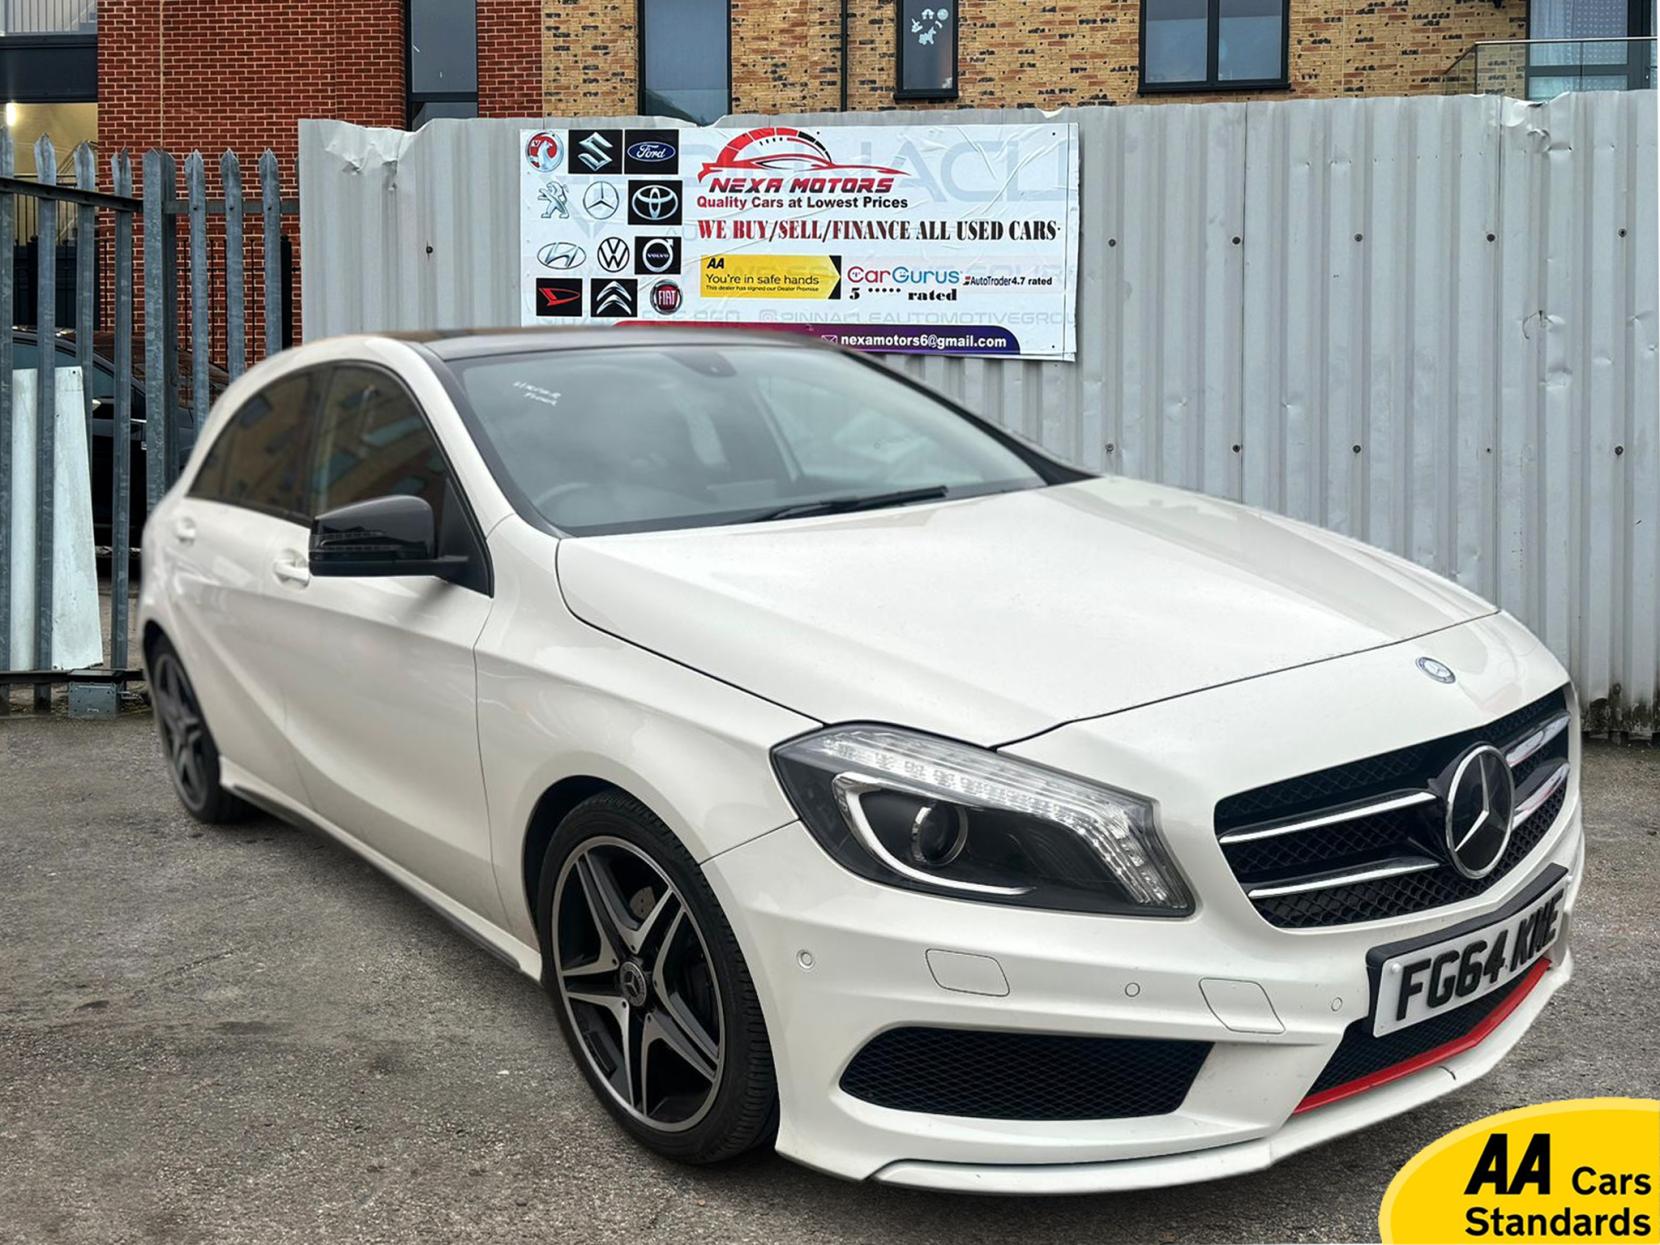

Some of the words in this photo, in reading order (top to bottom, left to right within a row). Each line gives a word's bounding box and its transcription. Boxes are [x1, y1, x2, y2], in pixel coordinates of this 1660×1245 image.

[636, 144, 666, 159] Ford
[709, 178, 784, 193] NEXA
[789, 178, 895, 193] MOTORS
[697, 196, 748, 210] Quality
[752, 196, 784, 208] Cars
[788, 197, 803, 208] at
[807, 197, 859, 209] Lowest
[863, 197, 908, 209] Prices
[697, 220, 727, 239] WE
[733, 220, 911, 242] BUY/SELL/FINANCE
[916, 221, 950, 240] ALL
[956, 220, 1004, 241] USED
[706, 257, 725, 269] AA
[705, 273, 741, 284] You're
[744, 274, 754, 284] in
[757, 274, 781, 285] safe
[784, 275, 820, 285] hands
[847, 266, 960, 284] CarGurus
[1028, 277, 1052, 286] rated
[658, 290, 676, 305] FIAT
[849, 287, 860, 300] 5
[908, 288, 957, 301] rated
[841, 334, 1007, 349] nexamotors6@gmail.com
[1396, 930, 1508, 1021] FG64
